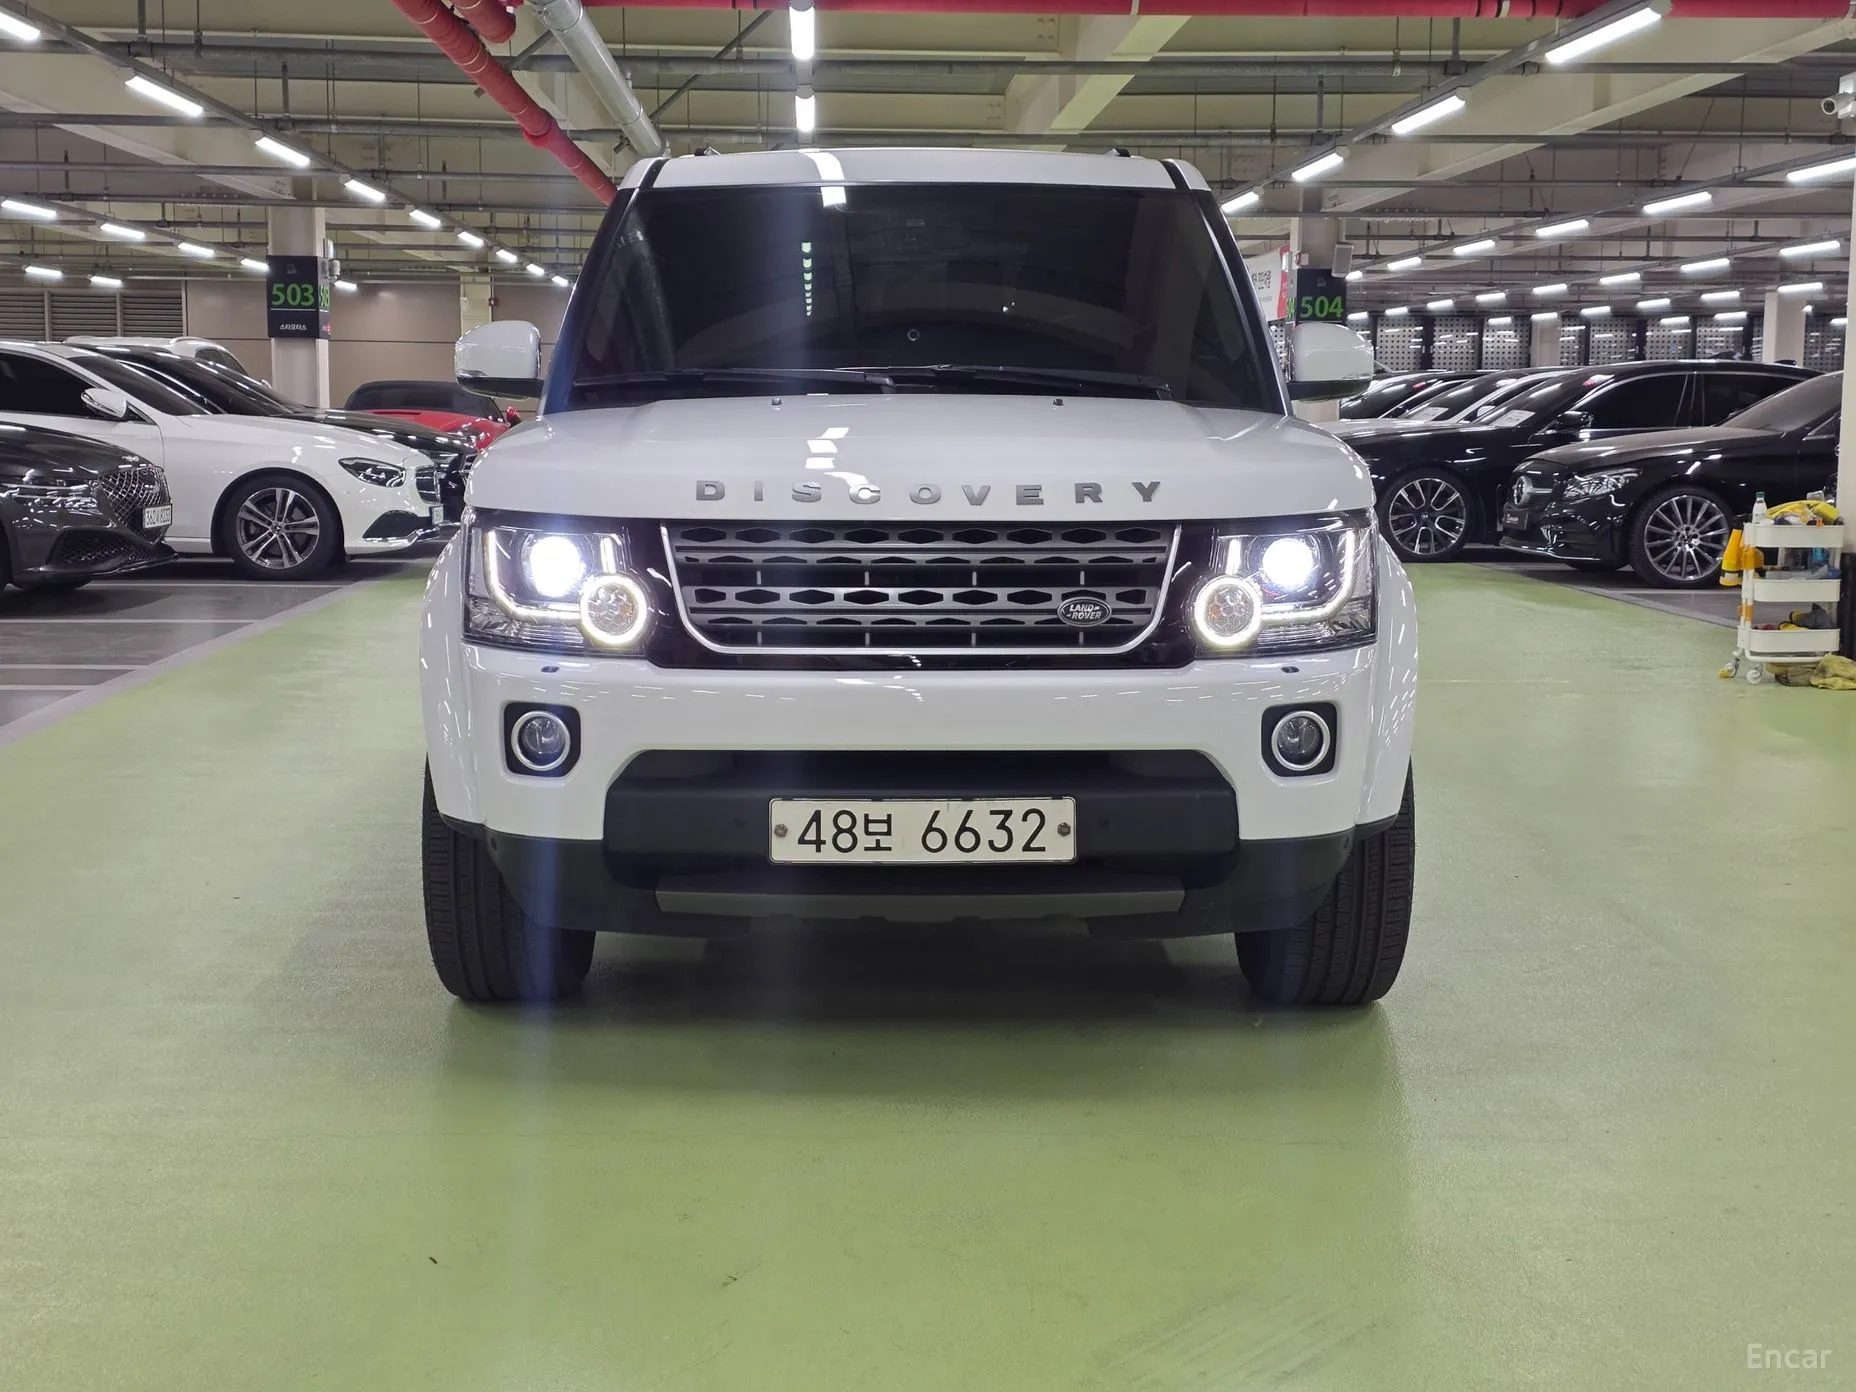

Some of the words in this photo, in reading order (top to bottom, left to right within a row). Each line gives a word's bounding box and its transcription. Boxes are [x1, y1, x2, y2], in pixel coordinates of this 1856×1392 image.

[271, 283, 315, 306] 503
[1300, 296, 1344, 318] 504
[696, 480, 1161, 506] DISCOVERY
[797, 809, 893, 854] 48보
[921, 808, 1046, 854] 6632
